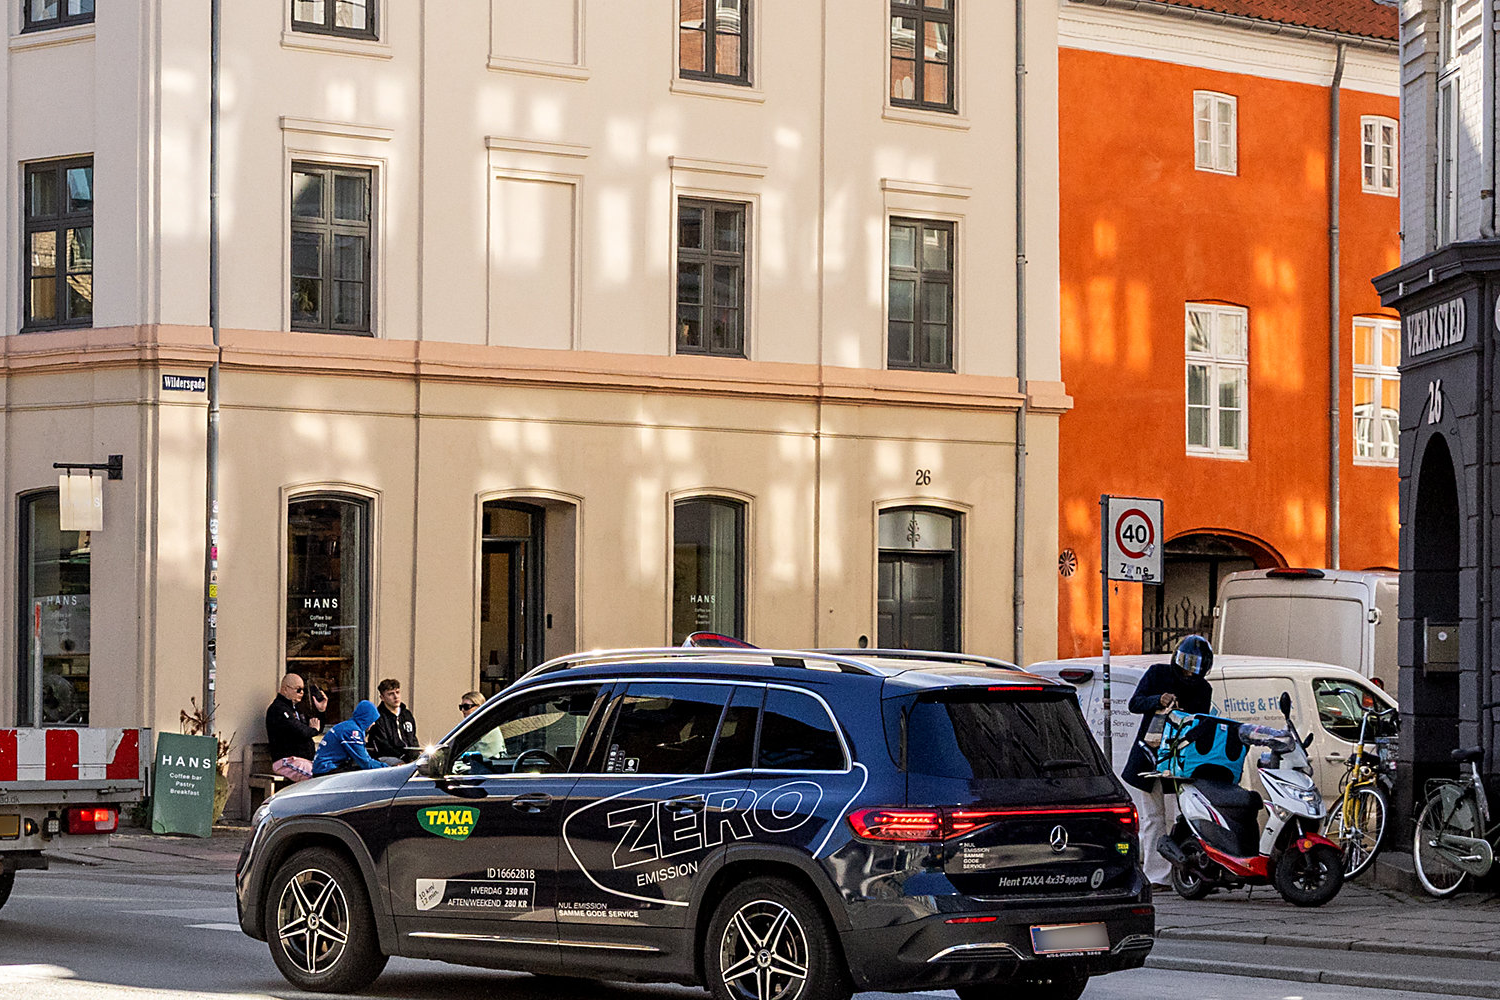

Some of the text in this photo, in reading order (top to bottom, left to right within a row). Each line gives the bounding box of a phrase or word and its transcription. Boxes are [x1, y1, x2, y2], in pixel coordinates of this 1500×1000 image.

[1406, 297, 1466, 358] VÆRKSTED
[164, 376, 205, 391] Wildersgade
[1428, 379, 1442, 424] 26
[915, 469, 931, 486] 26
[1122, 524, 1147, 544] 40
[1120, 563, 1149, 576] Zne
[47, 596, 77, 605] HANS
[304, 598, 338, 608] HANS
[690, 595, 715, 603] HANS
[1224, 696, 1293, 714] Flittig & Fli
[1112, 719, 1134, 727] Service
[162, 755, 211, 769] HANS
[170, 788, 200, 796] Breakfast
[426, 810, 473, 825] TAXA
[443, 826, 469, 835] 4x35
[607, 781, 823, 869] ZERO
[636, 861, 698, 887] EMISSION
[999, 875, 1087, 887] Hent TAXA 4x35 appen
[470, 887, 502, 895] HVERDAG
[505, 887, 518, 895] 230
[447, 899, 501, 907] AFTEN/WEEKEND
[518, 900, 528, 908] KR
[608, 910, 639, 918] SERVICE
